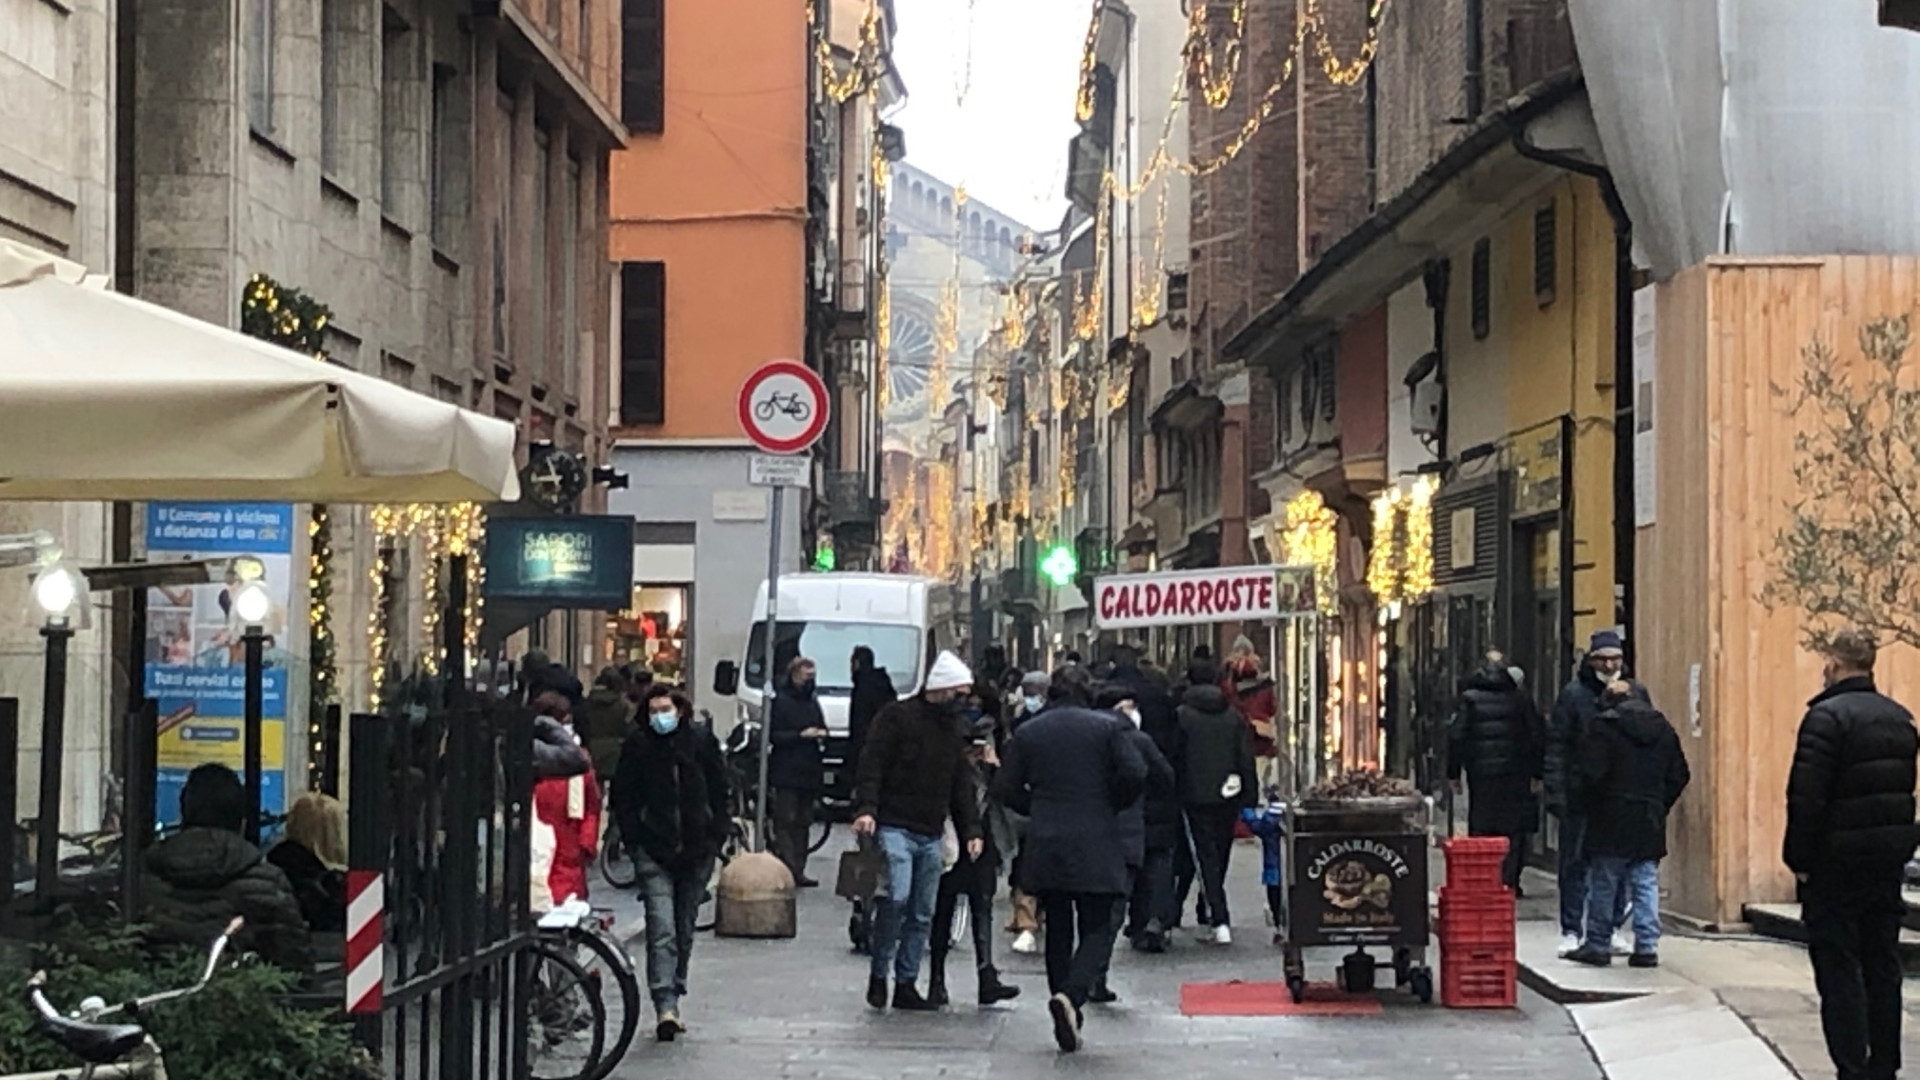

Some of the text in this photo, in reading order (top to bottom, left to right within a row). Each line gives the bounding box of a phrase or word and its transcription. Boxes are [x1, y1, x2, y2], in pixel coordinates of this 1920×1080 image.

[524, 531, 593, 549] SAPORI
[1101, 576, 1273, 620] CALDARROSTE
[1307, 839, 1410, 879] CALDARROSTE
